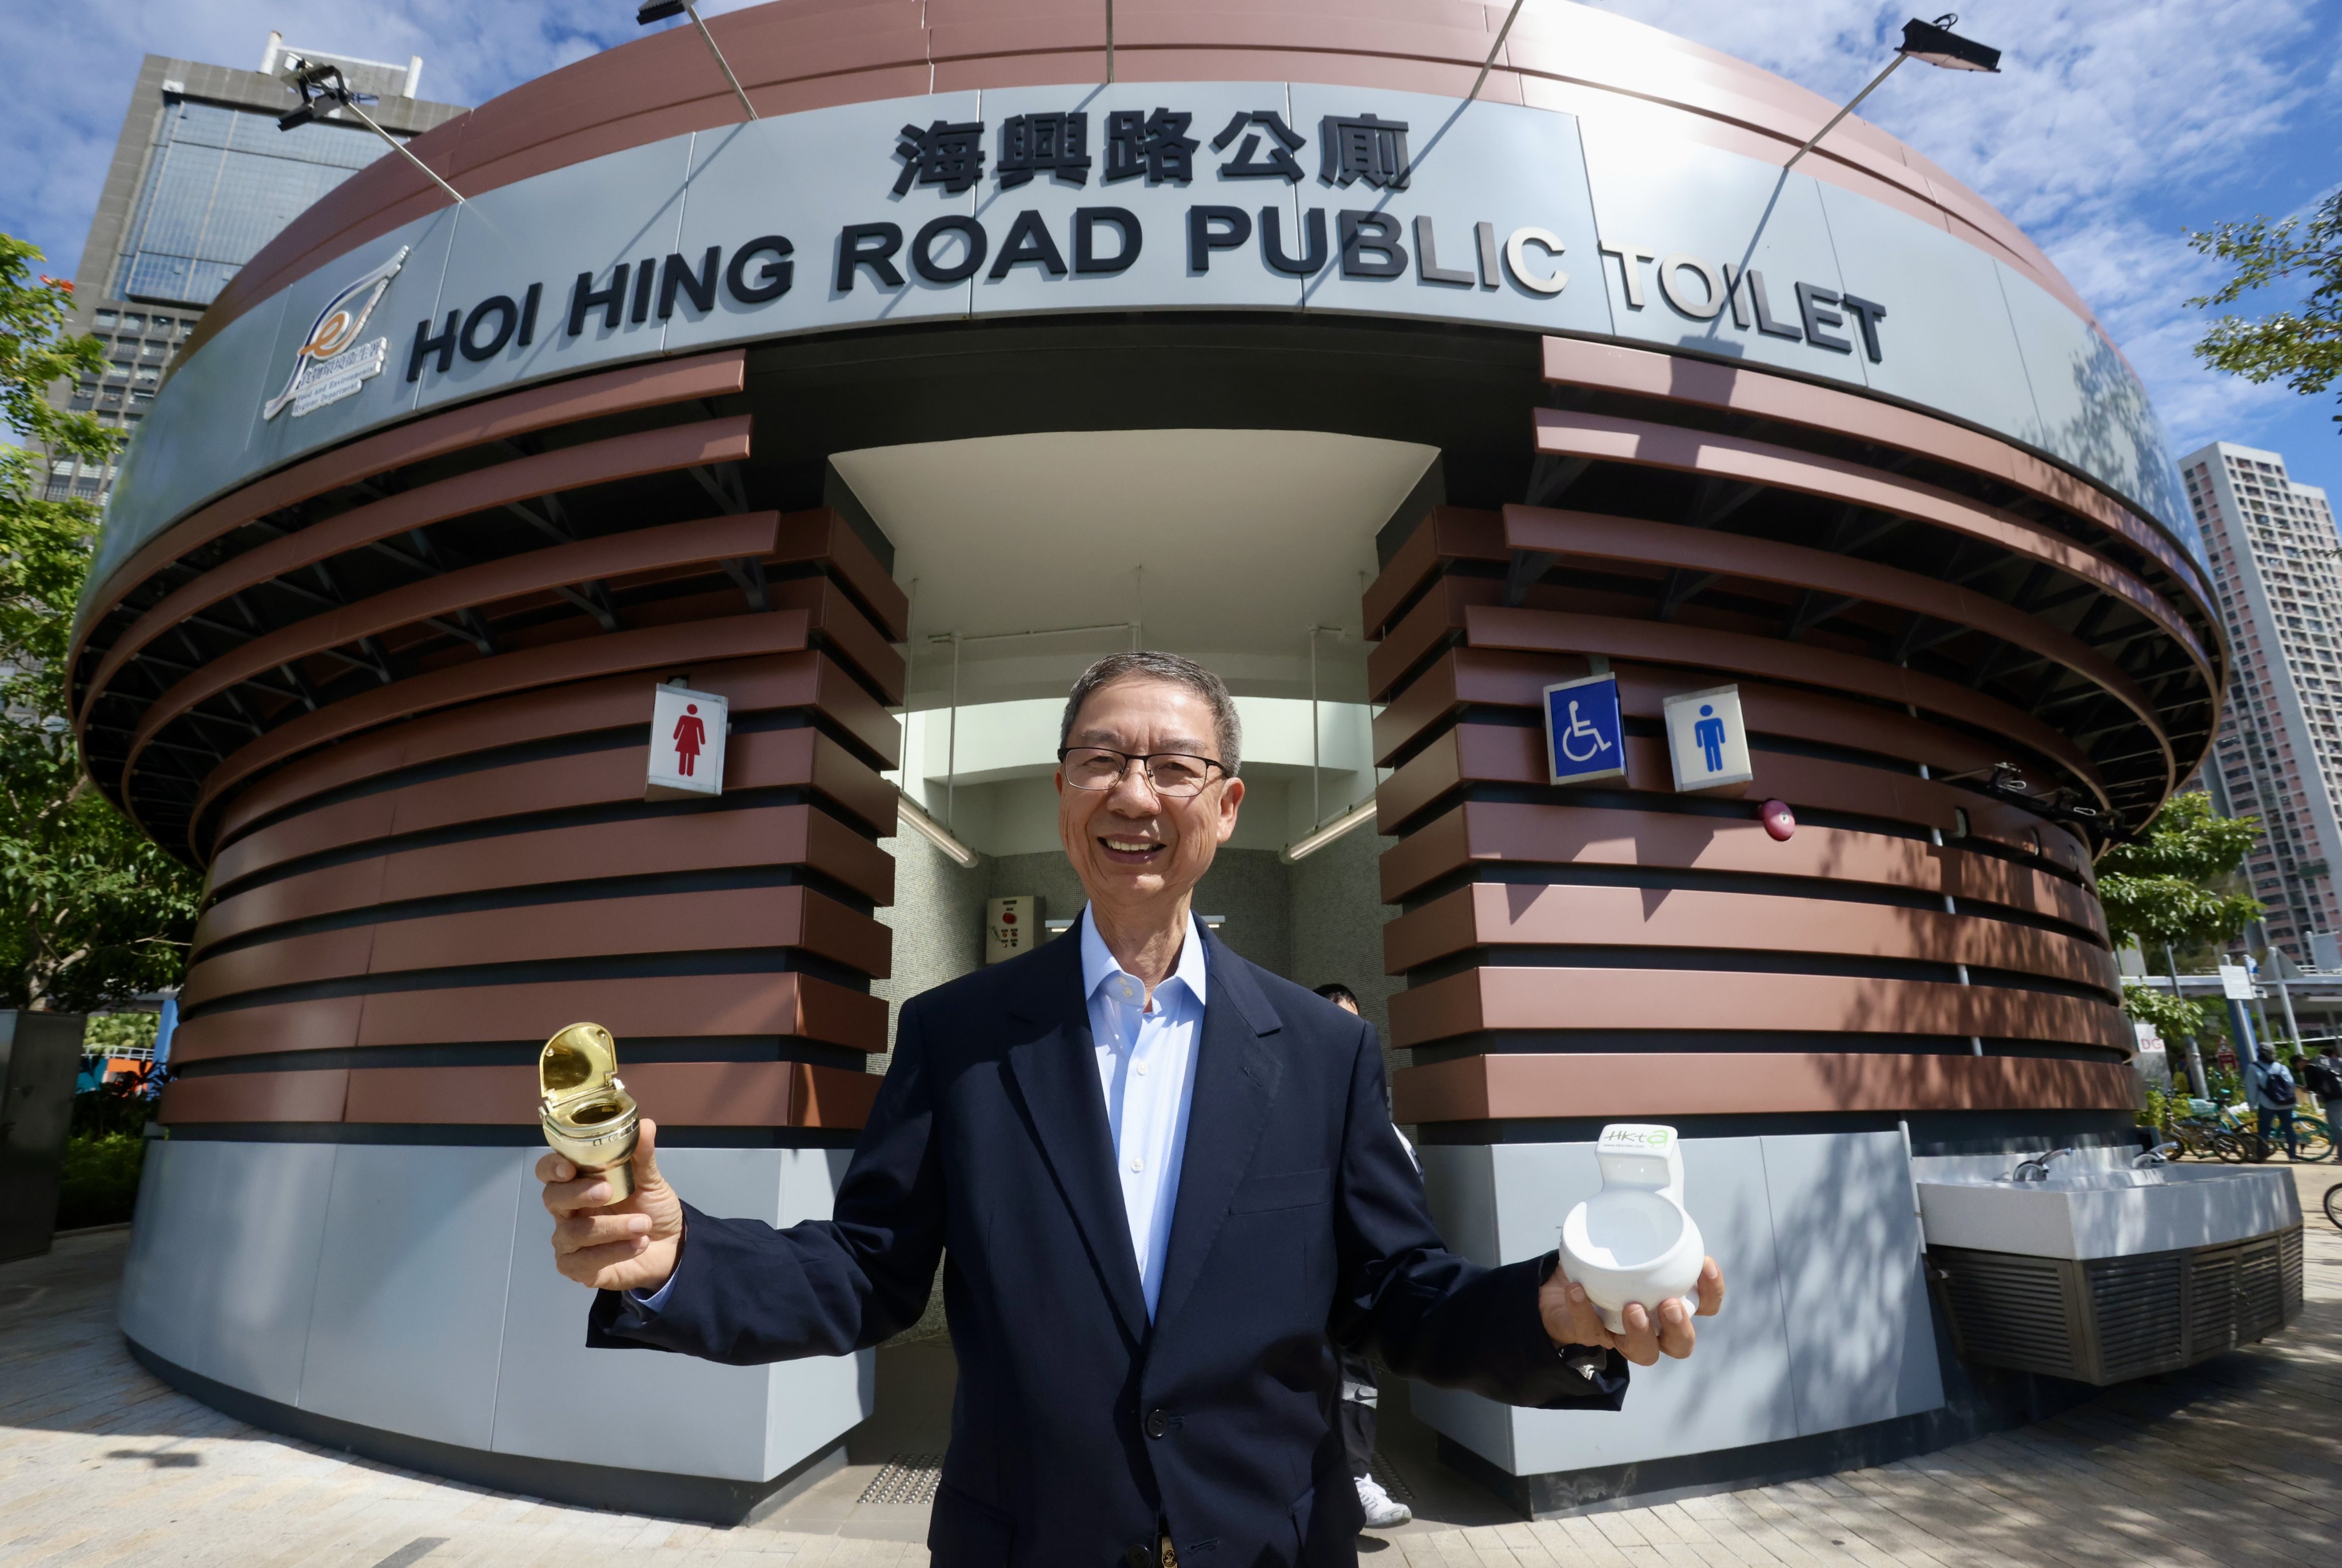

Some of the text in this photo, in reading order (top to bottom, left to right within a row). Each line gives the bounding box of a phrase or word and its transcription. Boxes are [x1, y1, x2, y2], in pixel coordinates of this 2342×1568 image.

[892, 107, 1410, 196] 海興路公廁
[407, 205, 1887, 382] HOI HING ROAD PUBLIC TOILET
[321, 382, 359, 402] Department
[329, 366, 375, 389] Environmental
